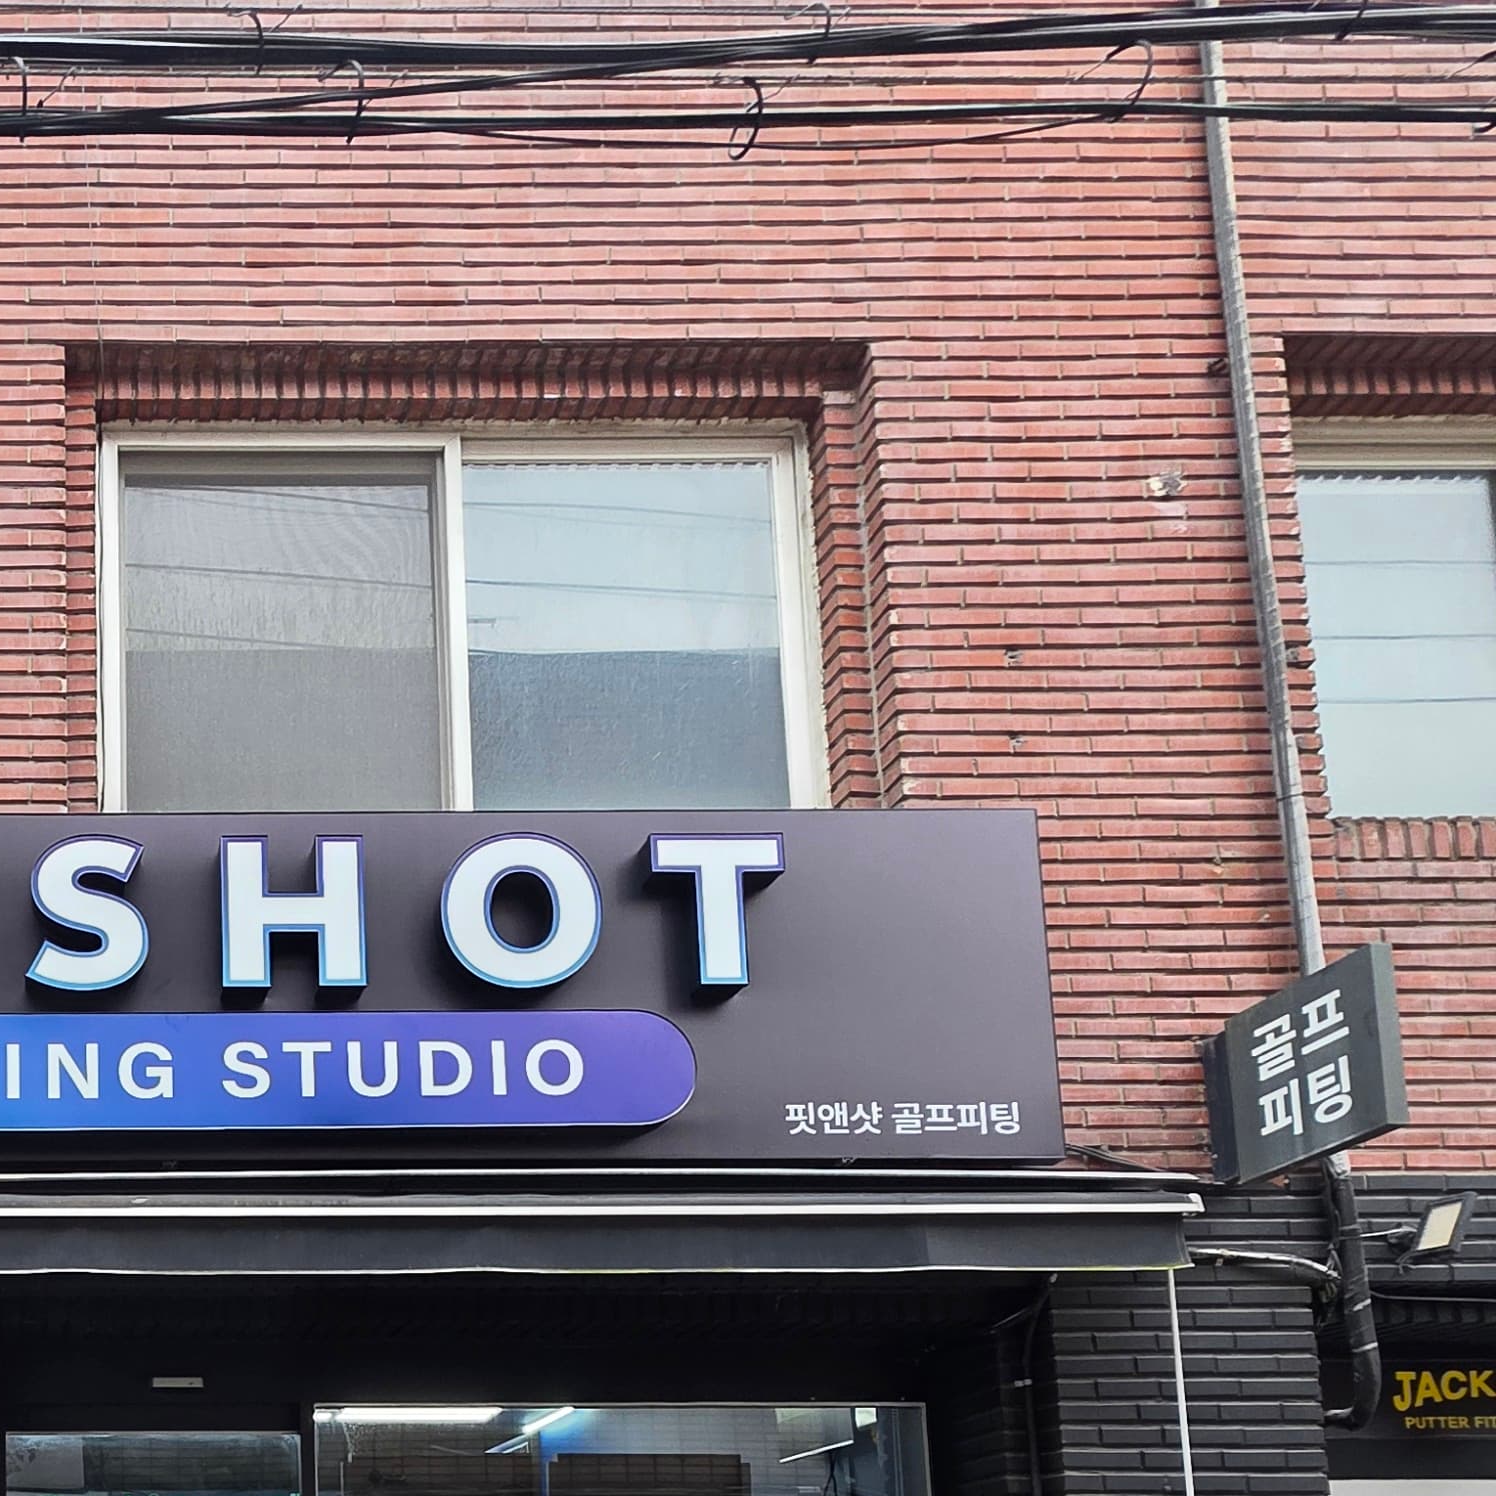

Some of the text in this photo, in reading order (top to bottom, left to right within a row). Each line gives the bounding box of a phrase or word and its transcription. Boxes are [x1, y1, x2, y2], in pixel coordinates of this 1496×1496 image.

[1251, 989, 1350, 1081] 골프
[222, 1038, 585, 1099] STUDIO
[1259, 1055, 1353, 1136] 피팅
[785, 1101, 1021, 1135] 핏앤샷 골프피팅
[1405, 1416, 1470, 1429] PUTTER
